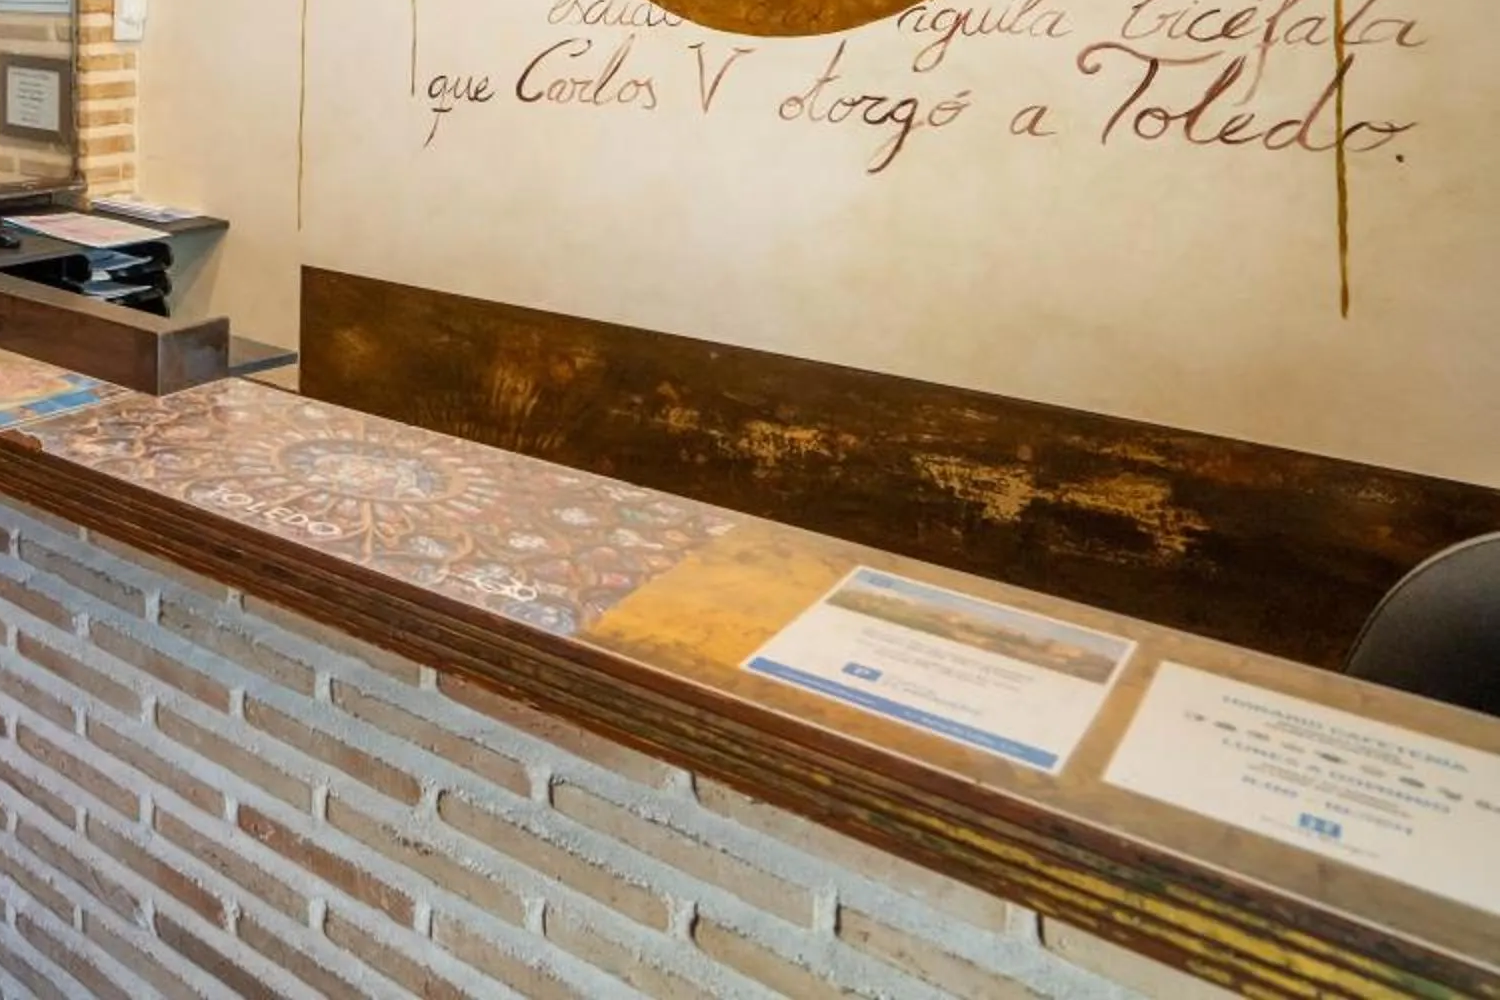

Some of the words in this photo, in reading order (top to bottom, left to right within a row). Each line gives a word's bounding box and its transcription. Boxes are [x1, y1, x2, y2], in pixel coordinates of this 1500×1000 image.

[423, 74, 495, 150] que
[514, 34, 658, 111] Carlos
[688, 40, 754, 114] V
[778, 38, 972, 175] otorgó
[1009, 100, 1059, 138] a
[1076, 40, 1422, 164] Toledo.
